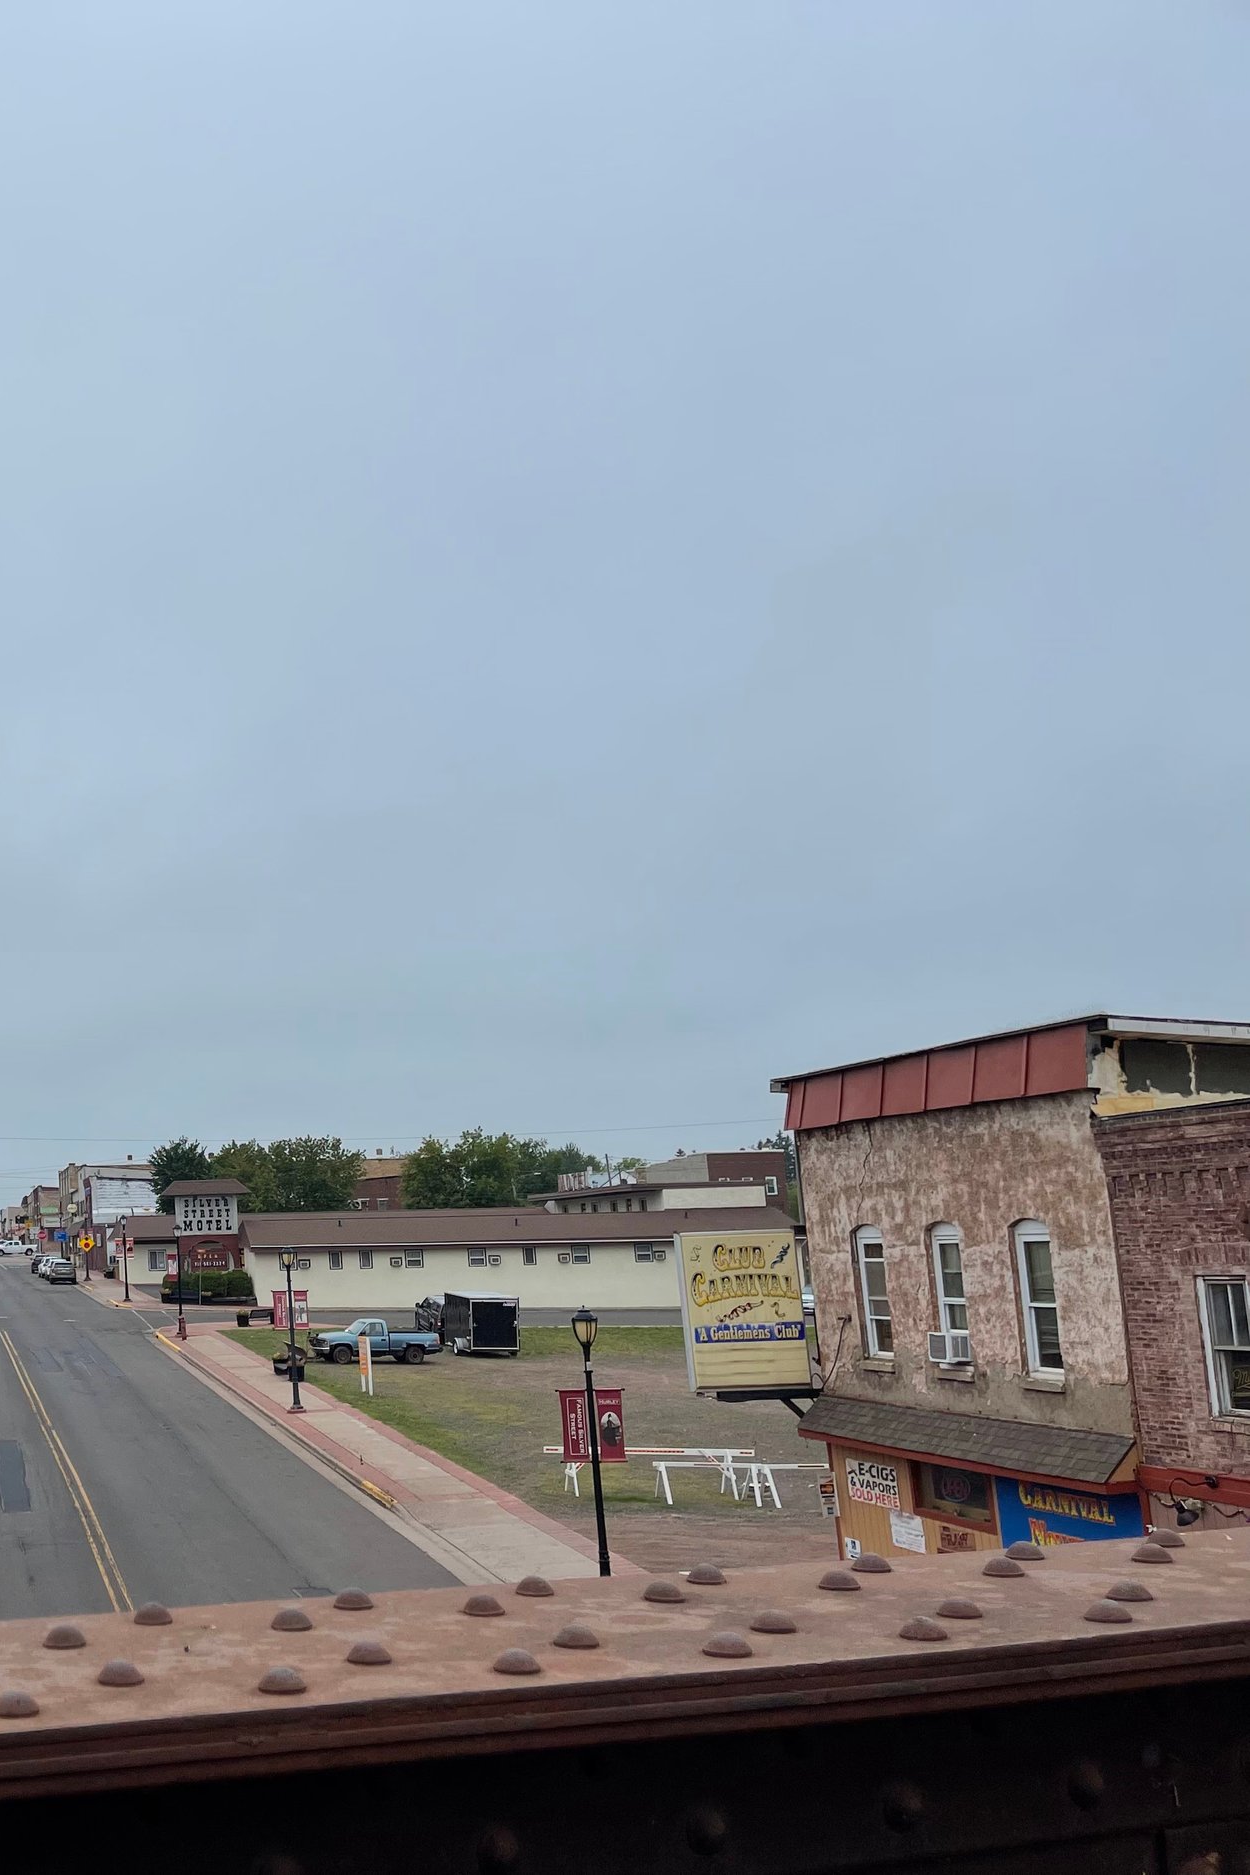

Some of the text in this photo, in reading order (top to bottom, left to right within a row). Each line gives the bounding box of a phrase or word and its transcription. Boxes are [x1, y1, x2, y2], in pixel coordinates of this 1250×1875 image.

[184, 1199, 229, 1208] SILVER
[184, 1209, 230, 1218] STREET
[183, 1220, 232, 1231] MOTEL
[712, 1243, 766, 1272] CLUB
[691, 1270, 801, 1308] CARNIVAL
[710, 1325, 771, 1341] Gentlemens
[569, 1413, 577, 1440] STREET
[576, 1399, 585, 1454] FAMOUS SILVER
[857, 1462, 897, 1483] E-CIGS
[850, 1476, 898, 1497] & VAPORS
[851, 1486, 874, 1503] SOLD
[875, 1493, 900, 1509] HERE
